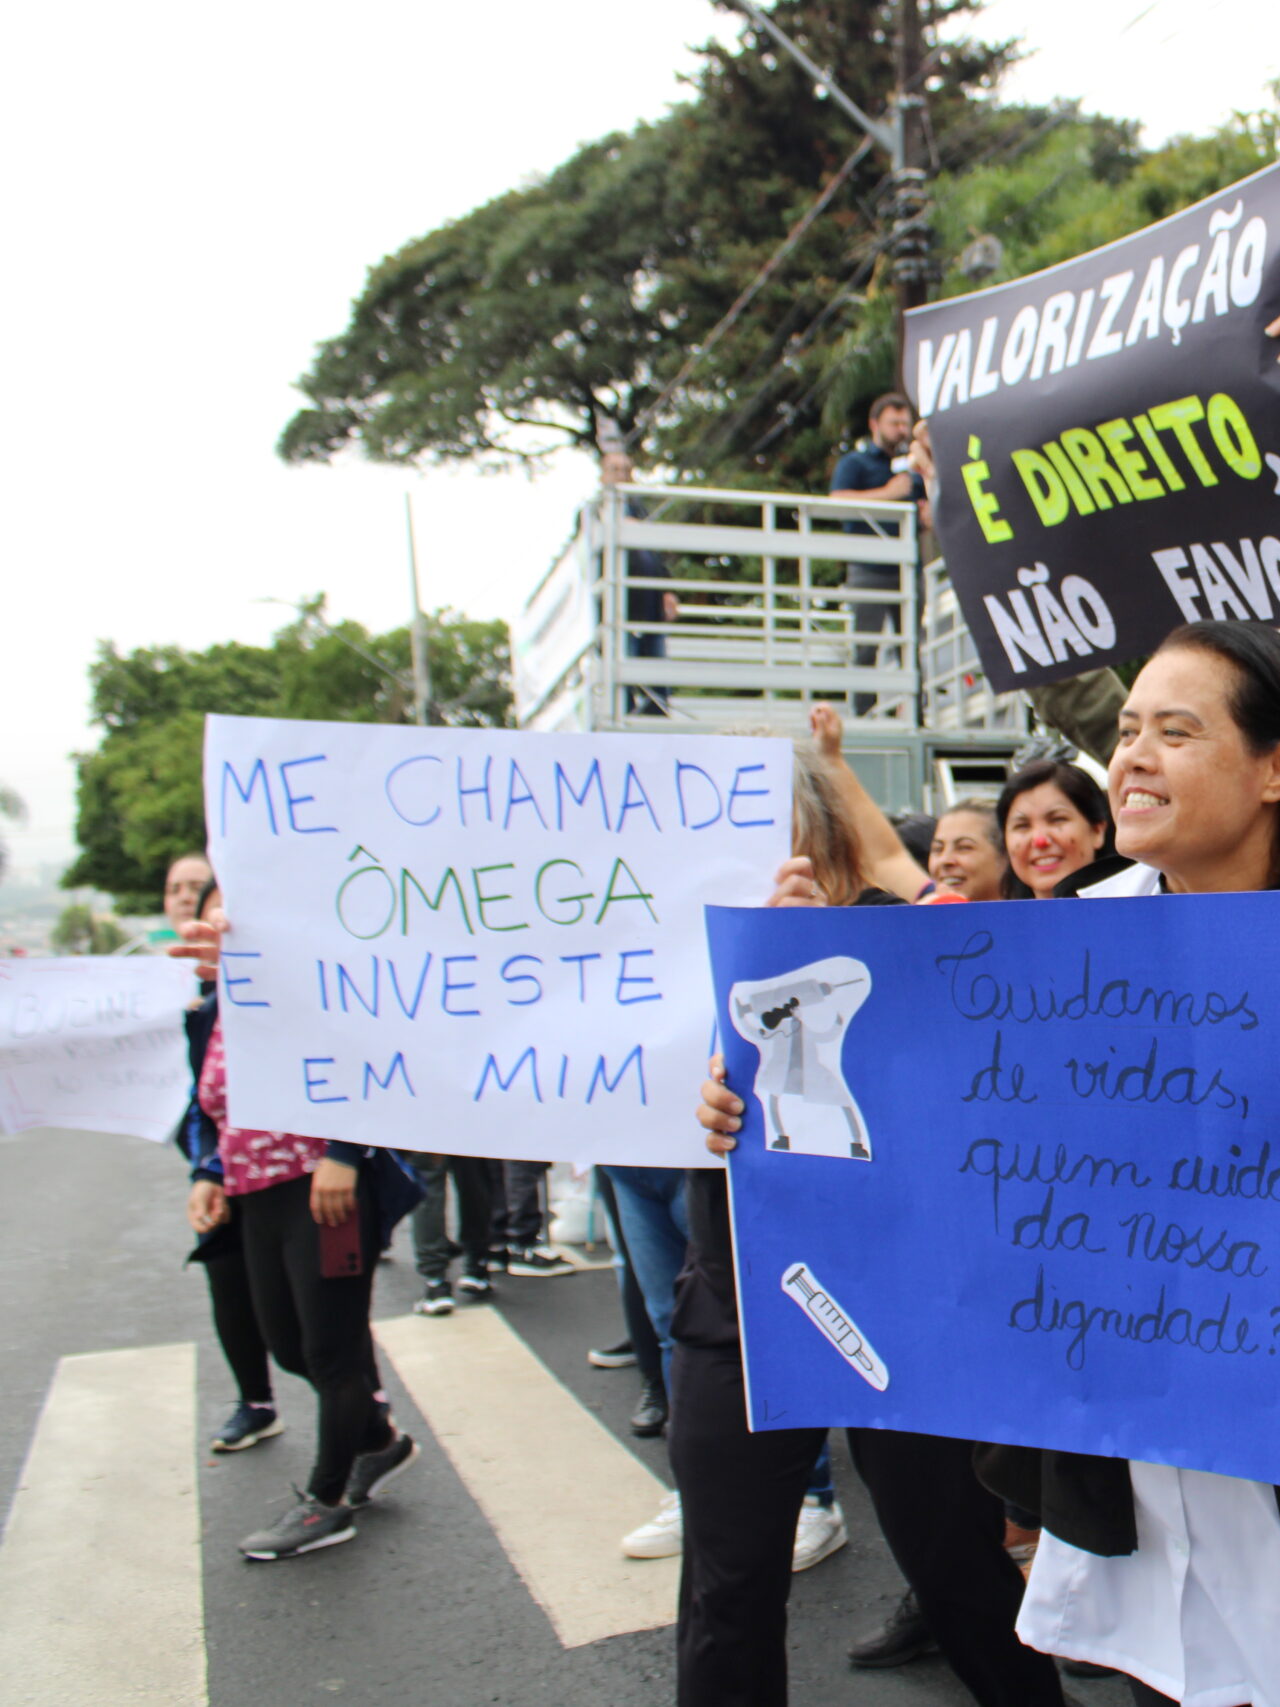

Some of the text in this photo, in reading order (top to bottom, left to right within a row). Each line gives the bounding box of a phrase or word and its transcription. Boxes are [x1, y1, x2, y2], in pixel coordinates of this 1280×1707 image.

[917, 199, 1267, 417] VALORIZAÇÃO
[961, 434, 1014, 544] É
[983, 562, 1117, 674] NÃO
[220, 755, 339, 838] ME
[336, 844, 660, 940] ÔMEGA
[219, 949, 663, 1020] E INVESTE
[935, 931, 1260, 1031] Cuidamos
[303, 1045, 649, 1106] EM MIM
[961, 1030, 1249, 1119] de vidas,
[958, 1137, 1152, 1236] quem
[1011, 1186, 1269, 1277] da nossa
